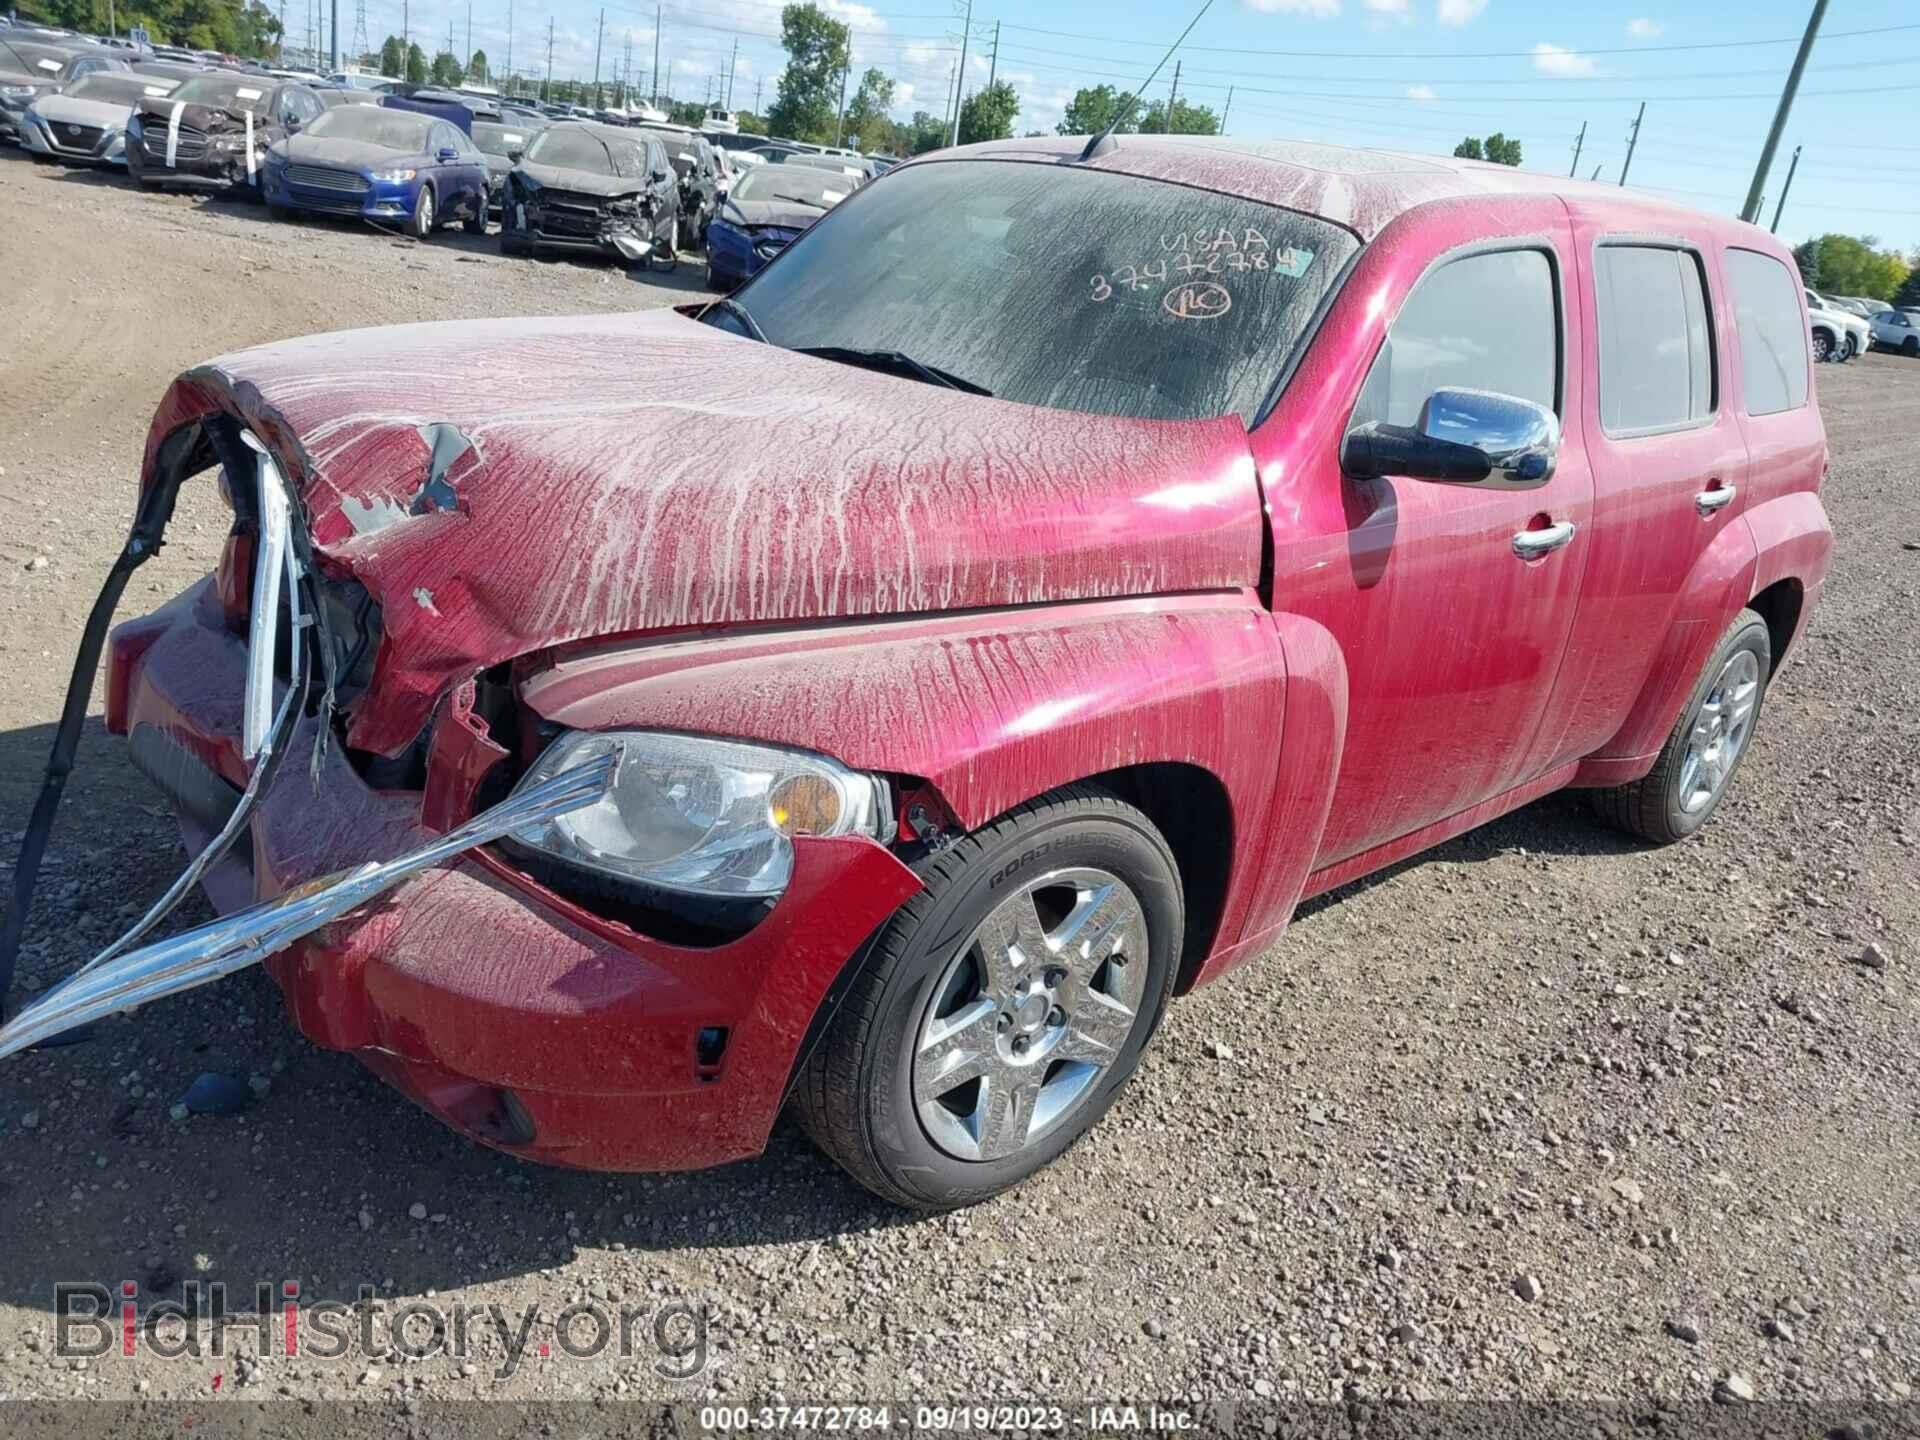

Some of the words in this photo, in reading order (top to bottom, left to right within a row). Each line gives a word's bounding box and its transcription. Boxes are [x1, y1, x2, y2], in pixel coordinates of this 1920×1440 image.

[1161, 228, 1271, 251] USAA
[1090, 246, 1296, 302] 37472784
[990, 843, 1049, 888] ROAD
